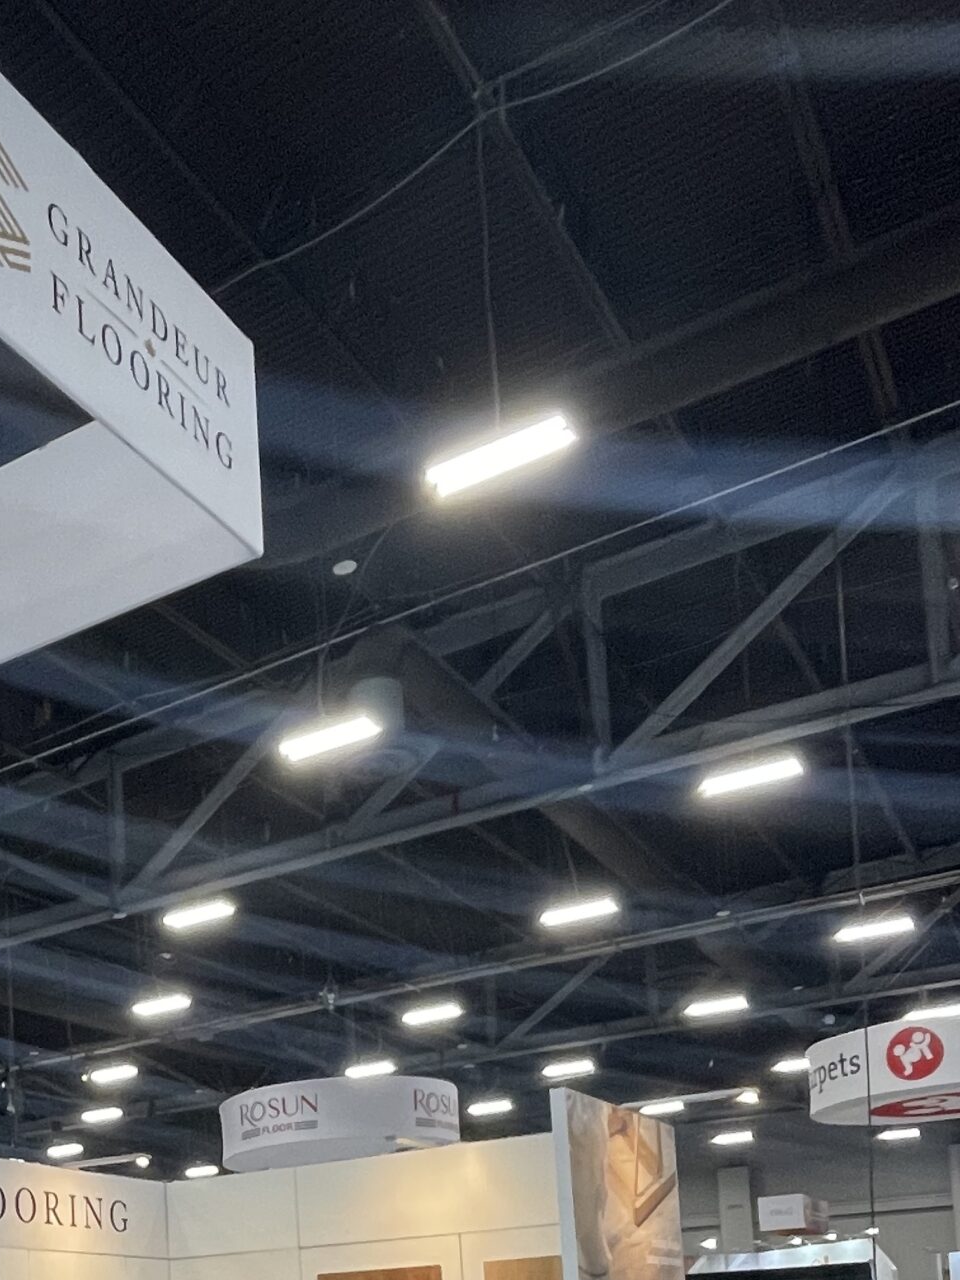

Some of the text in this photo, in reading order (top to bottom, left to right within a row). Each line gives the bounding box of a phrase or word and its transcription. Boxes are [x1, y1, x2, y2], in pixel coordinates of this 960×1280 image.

[47, 203, 231, 408] GRANDEUR
[50, 269, 233, 470] FLOORING
[240, 1093, 319, 1127] ROSUN
